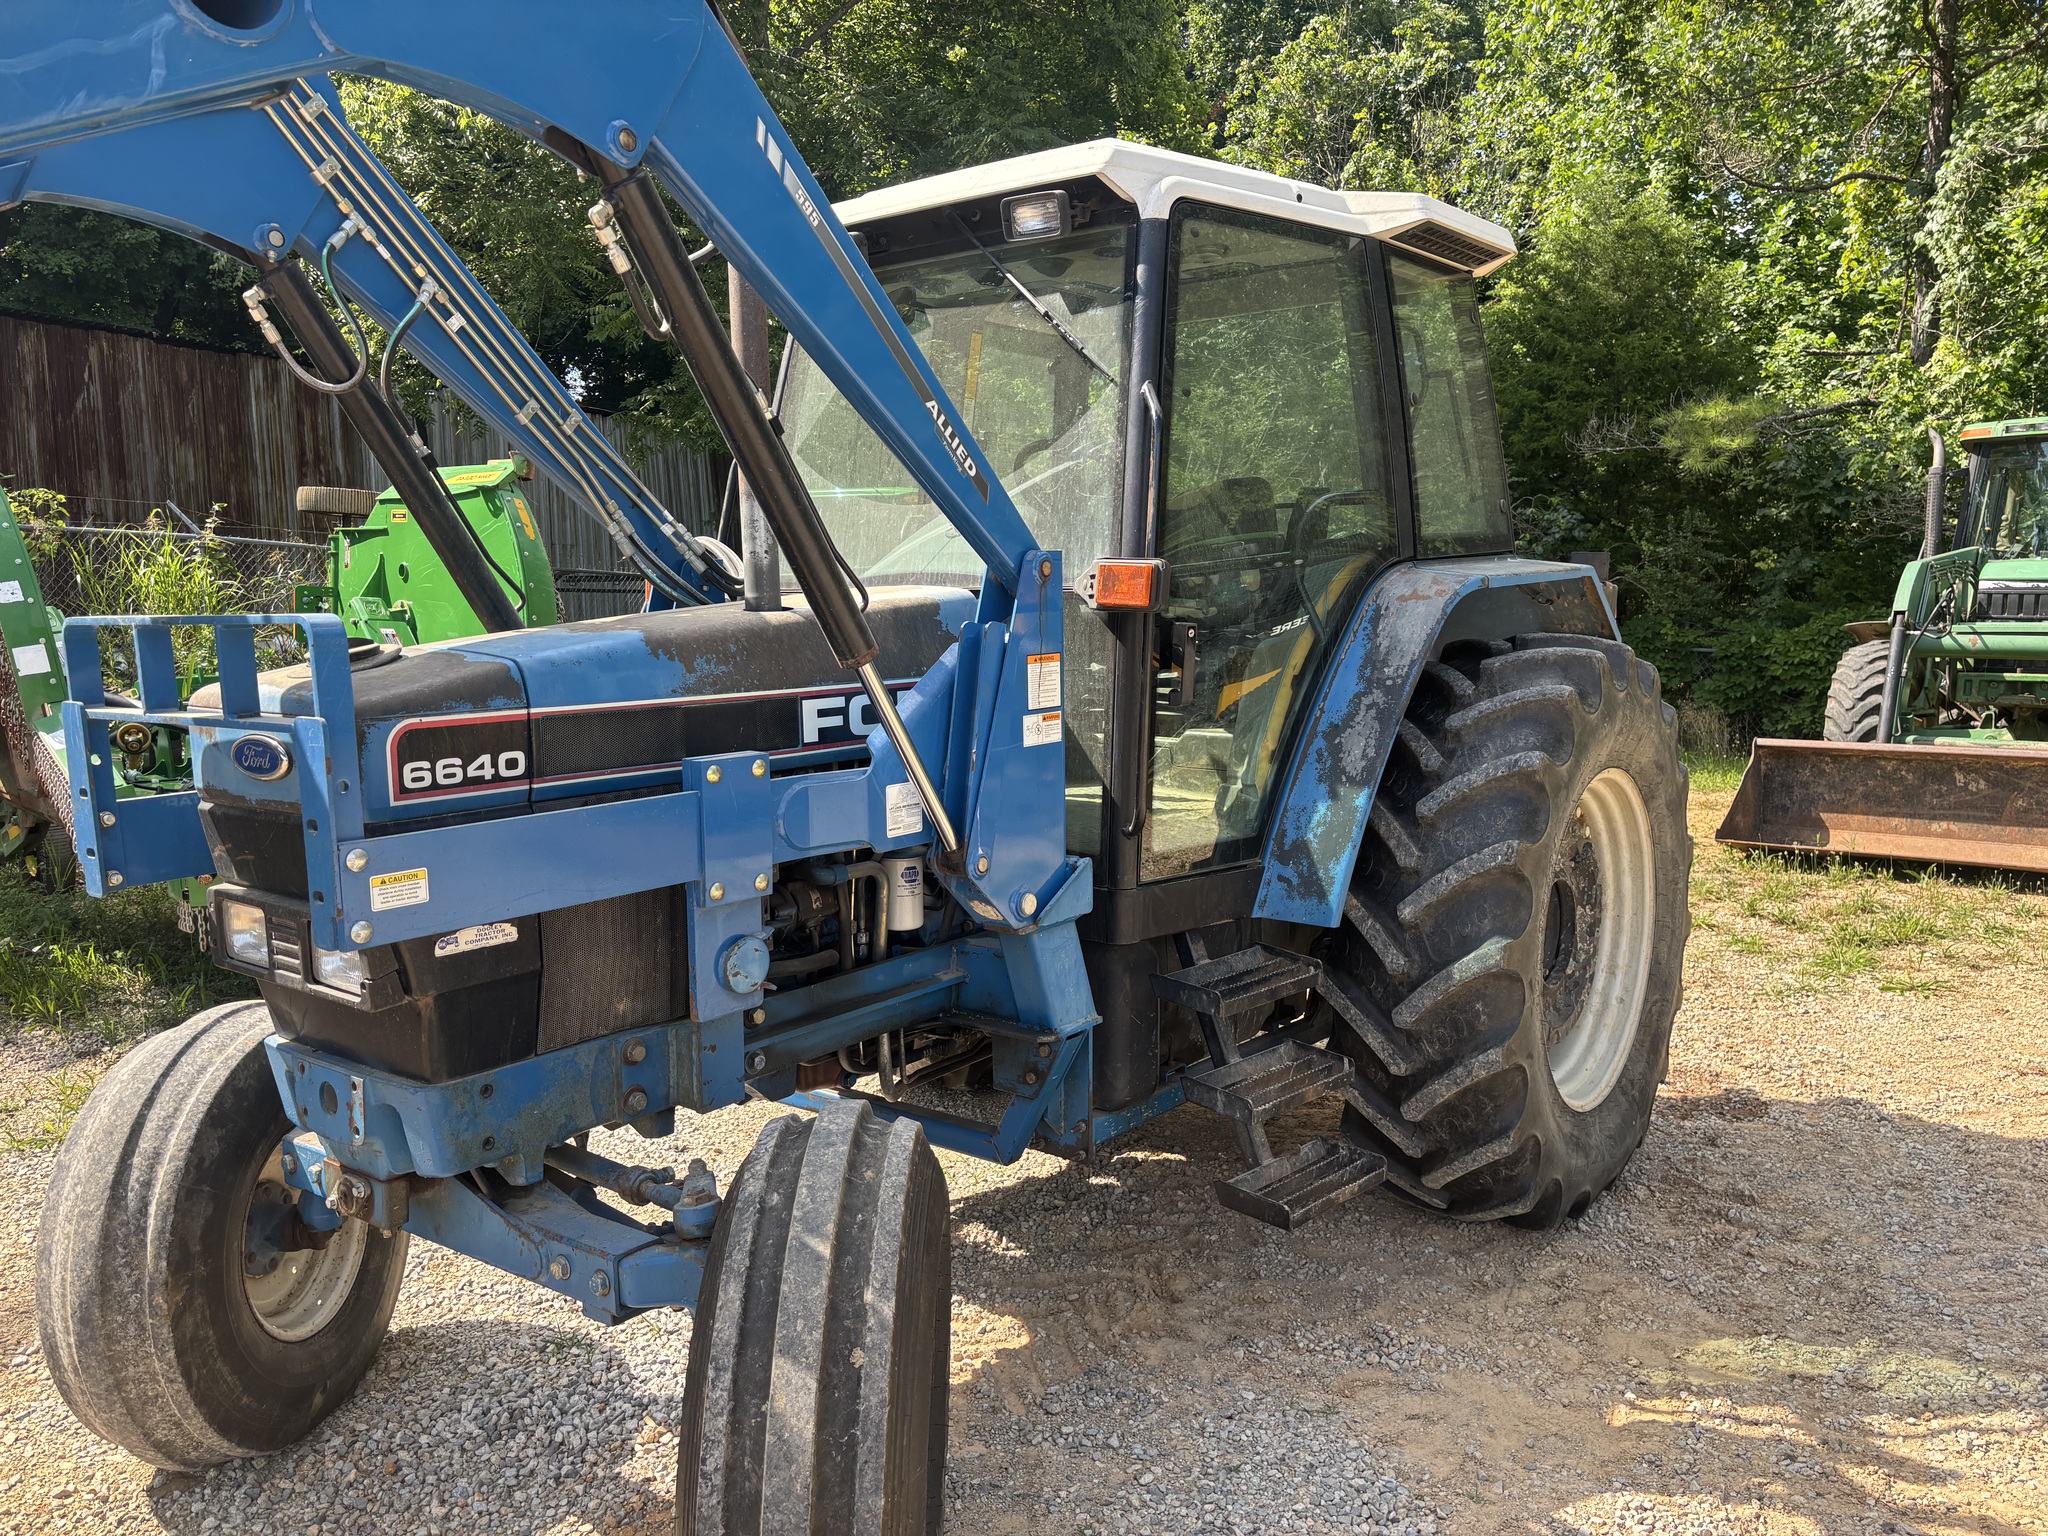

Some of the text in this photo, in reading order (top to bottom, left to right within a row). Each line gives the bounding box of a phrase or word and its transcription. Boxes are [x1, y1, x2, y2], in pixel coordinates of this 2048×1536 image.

[795, 188, 821, 227] 595
[925, 400, 977, 477] ALLIED
[242, 745, 271, 769] Ford
[403, 750, 526, 789] 6640
[387, 873, 419, 884] CAUTION
[464, 935, 500, 946] COMPANY,
[474, 928, 506, 938] TRACTOR
